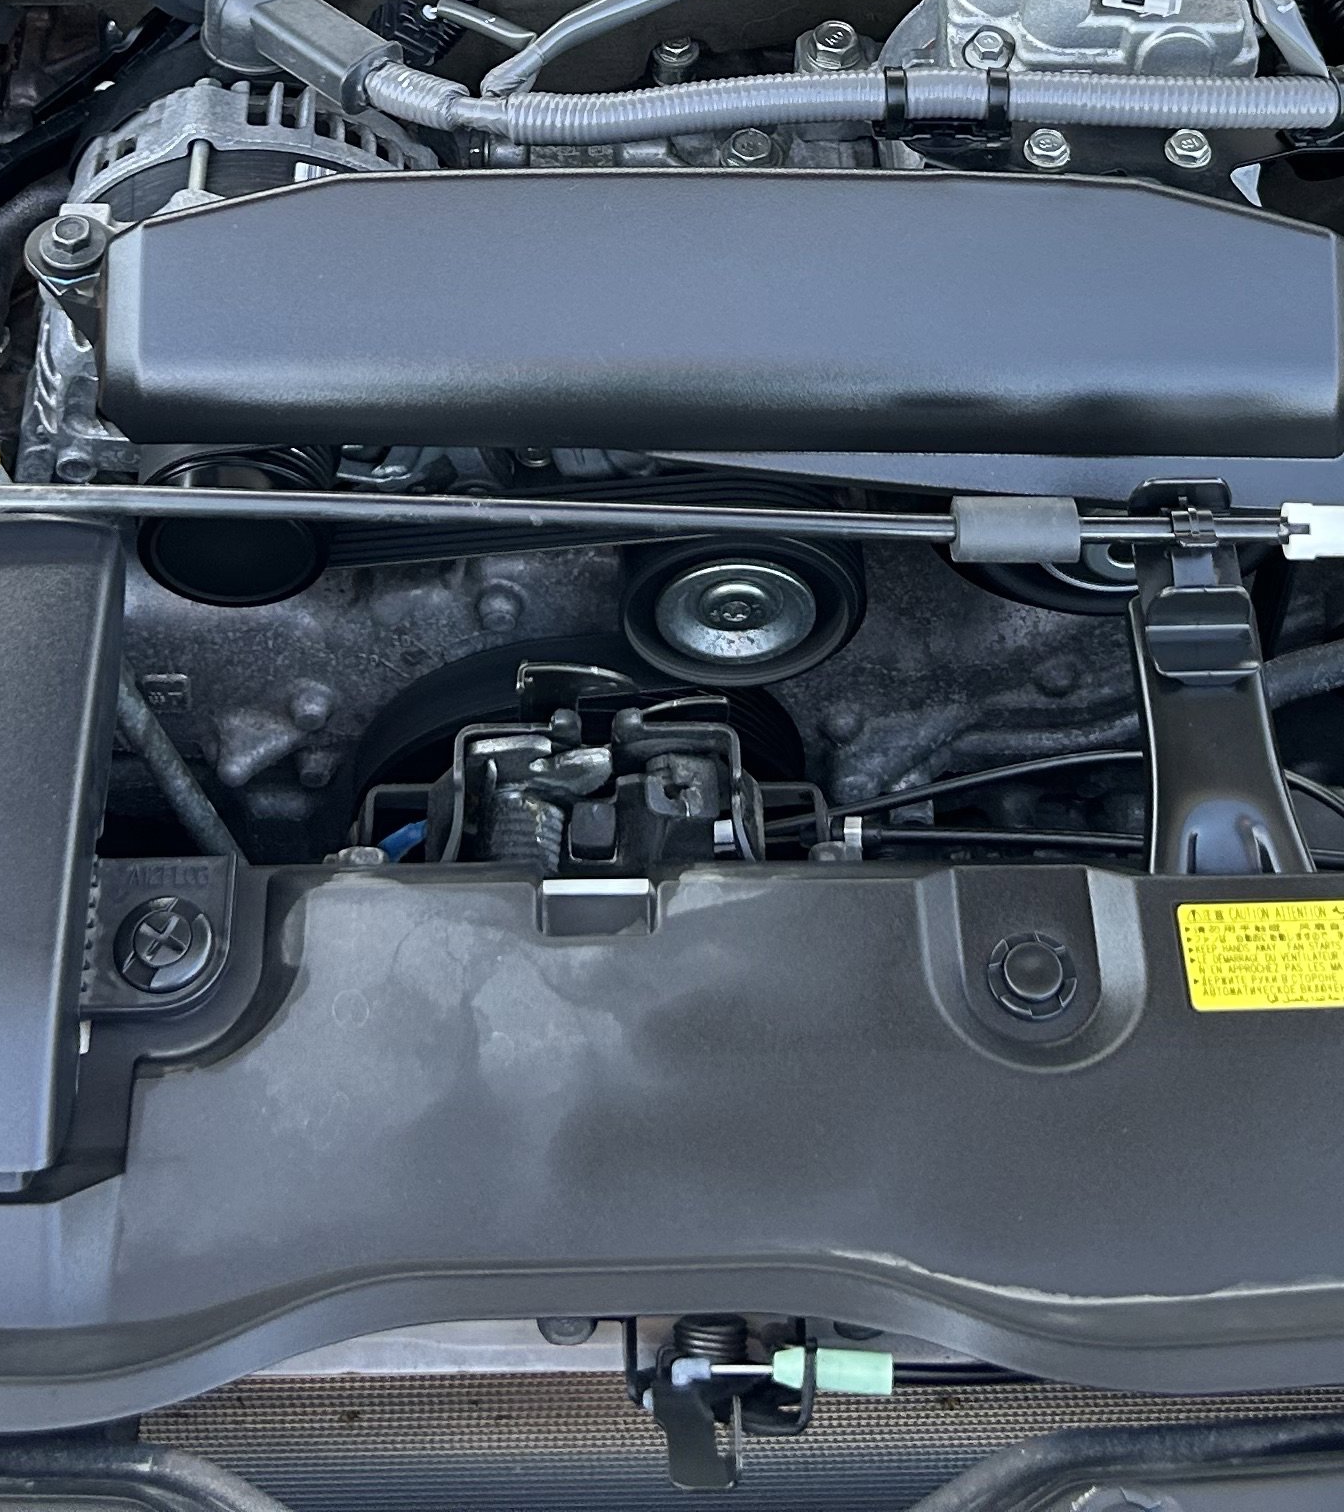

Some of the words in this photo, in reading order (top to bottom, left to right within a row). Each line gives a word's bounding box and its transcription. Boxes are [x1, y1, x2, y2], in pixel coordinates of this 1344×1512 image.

[1229, 907, 1269, 921] CAUTION
[1276, 905, 1327, 920] ATTENTION
[1195, 944, 1217, 953] KEEP
[1222, 944, 1249, 952] HANDS
[1287, 943, 1304, 951] FAN
[1309, 940, 1341, 949] STARTS
[1197, 954, 1207, 964] LE
[1265, 953, 1276, 962] DU
[1282, 951, 1338, 962] VENTILATEUR
[1229, 963, 1278, 974] APPROCHEZ
[1285, 963, 1303, 972] PAS
[1308, 962, 1325, 972] LES
[1252, 974, 1277, 984] РУКИ
[1292, 973, 1336, 983] СТОРОНЕ
